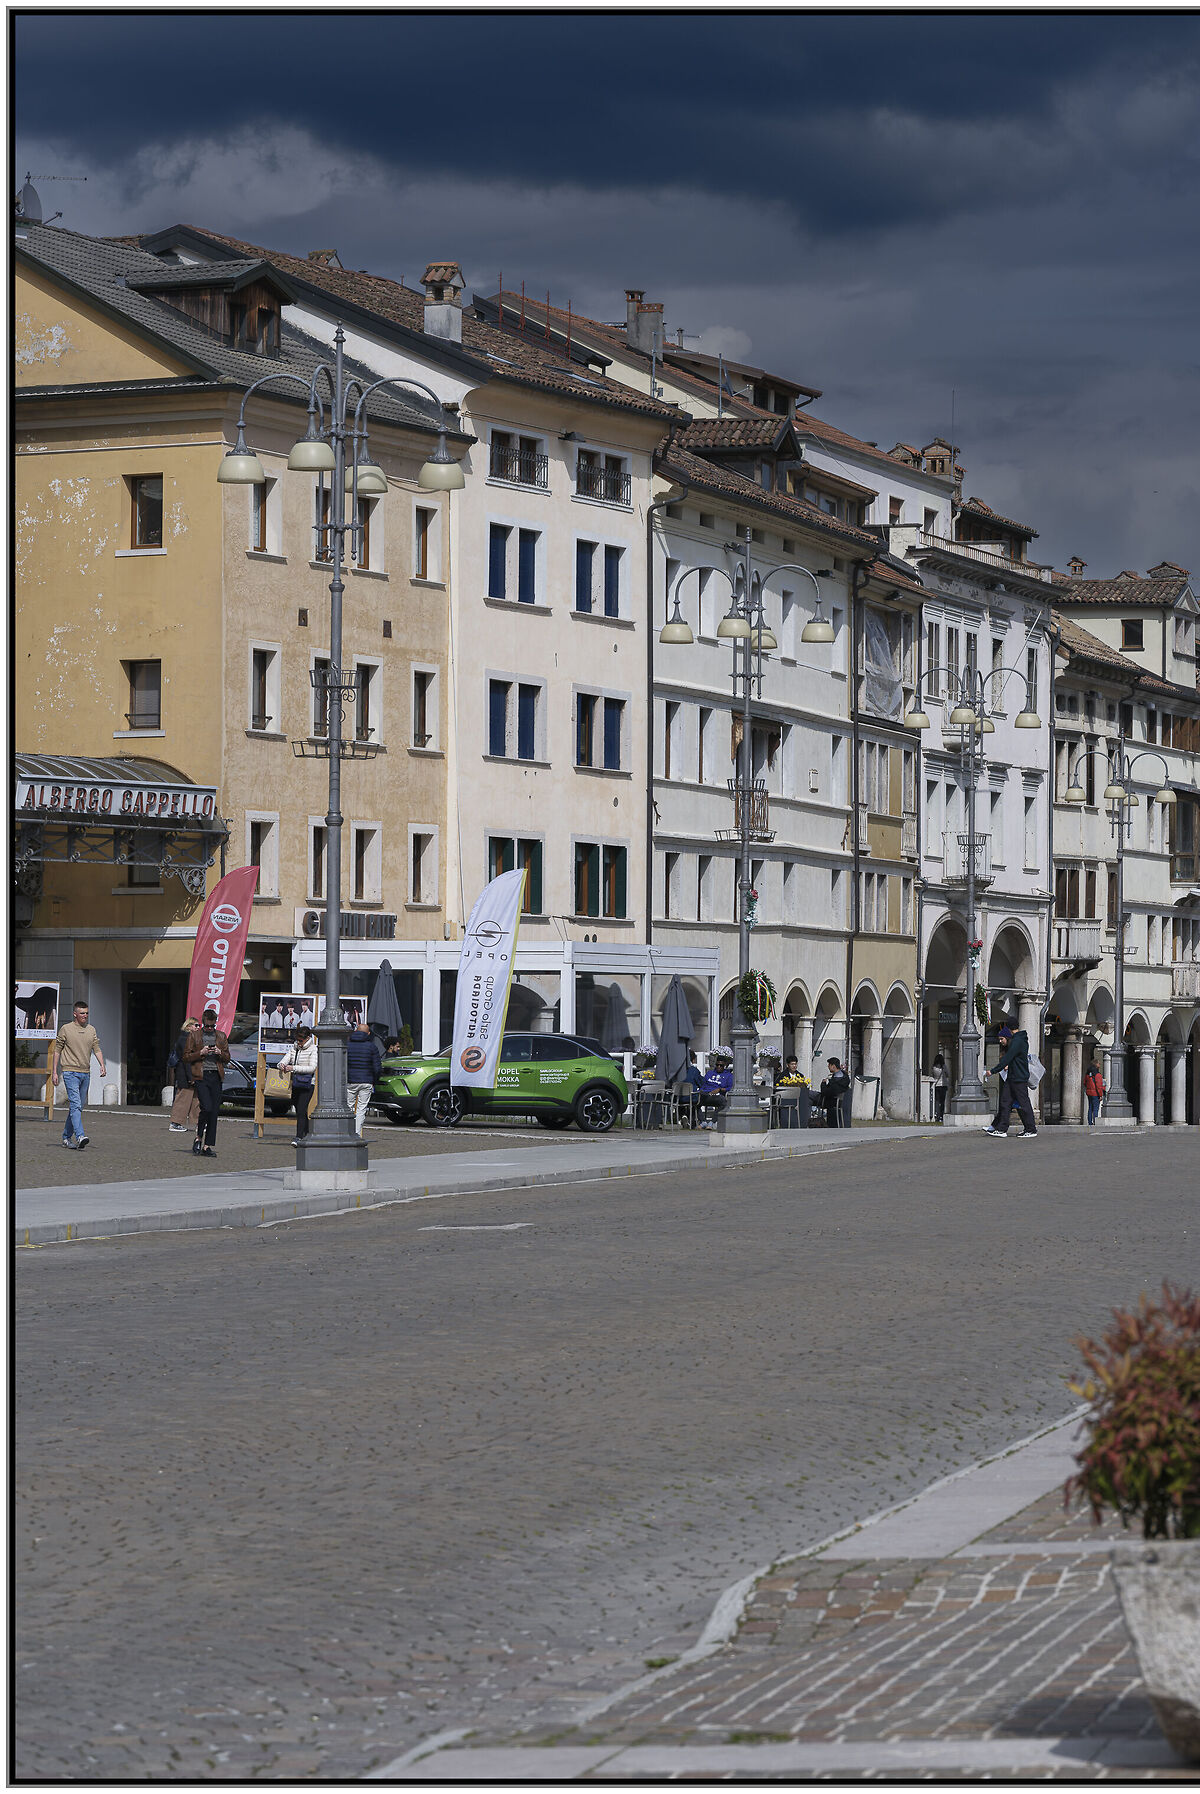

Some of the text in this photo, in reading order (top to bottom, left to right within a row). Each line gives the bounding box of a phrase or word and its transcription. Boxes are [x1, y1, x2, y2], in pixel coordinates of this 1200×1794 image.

[24, 785, 214, 819] ALBERGO CAPPELLO
[269, 1077, 289, 1089] OVS
